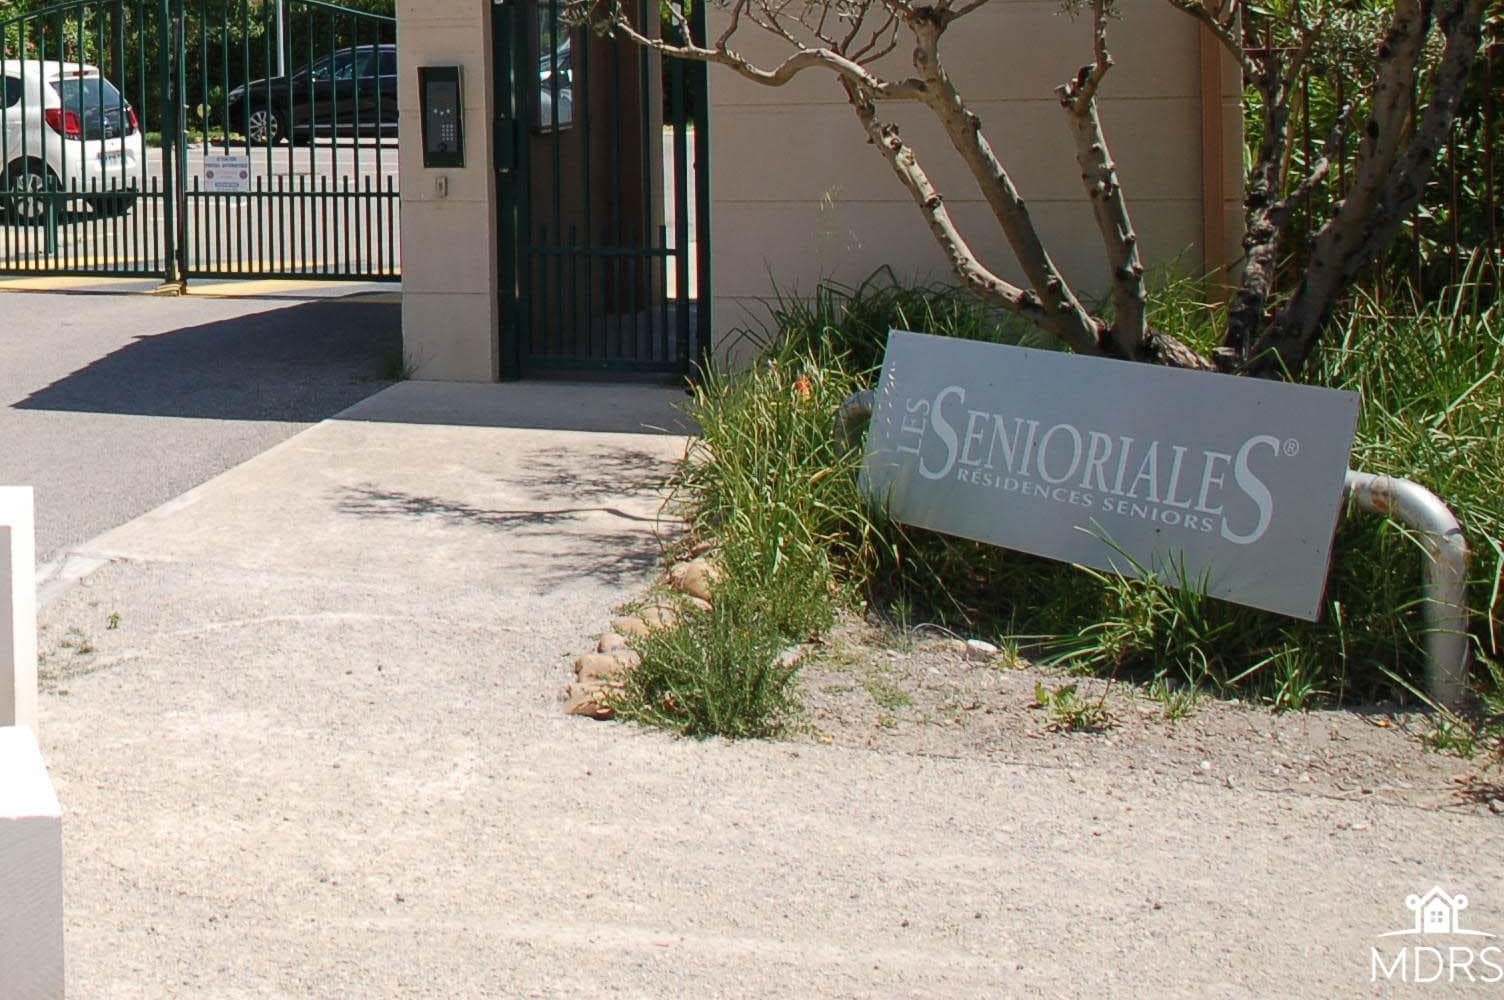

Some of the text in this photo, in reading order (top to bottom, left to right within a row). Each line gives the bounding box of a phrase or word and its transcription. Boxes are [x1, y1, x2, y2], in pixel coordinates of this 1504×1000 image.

[897, 397, 930, 456] LES
[957, 466, 1214, 532] RÉSIDENCES SENIORS
